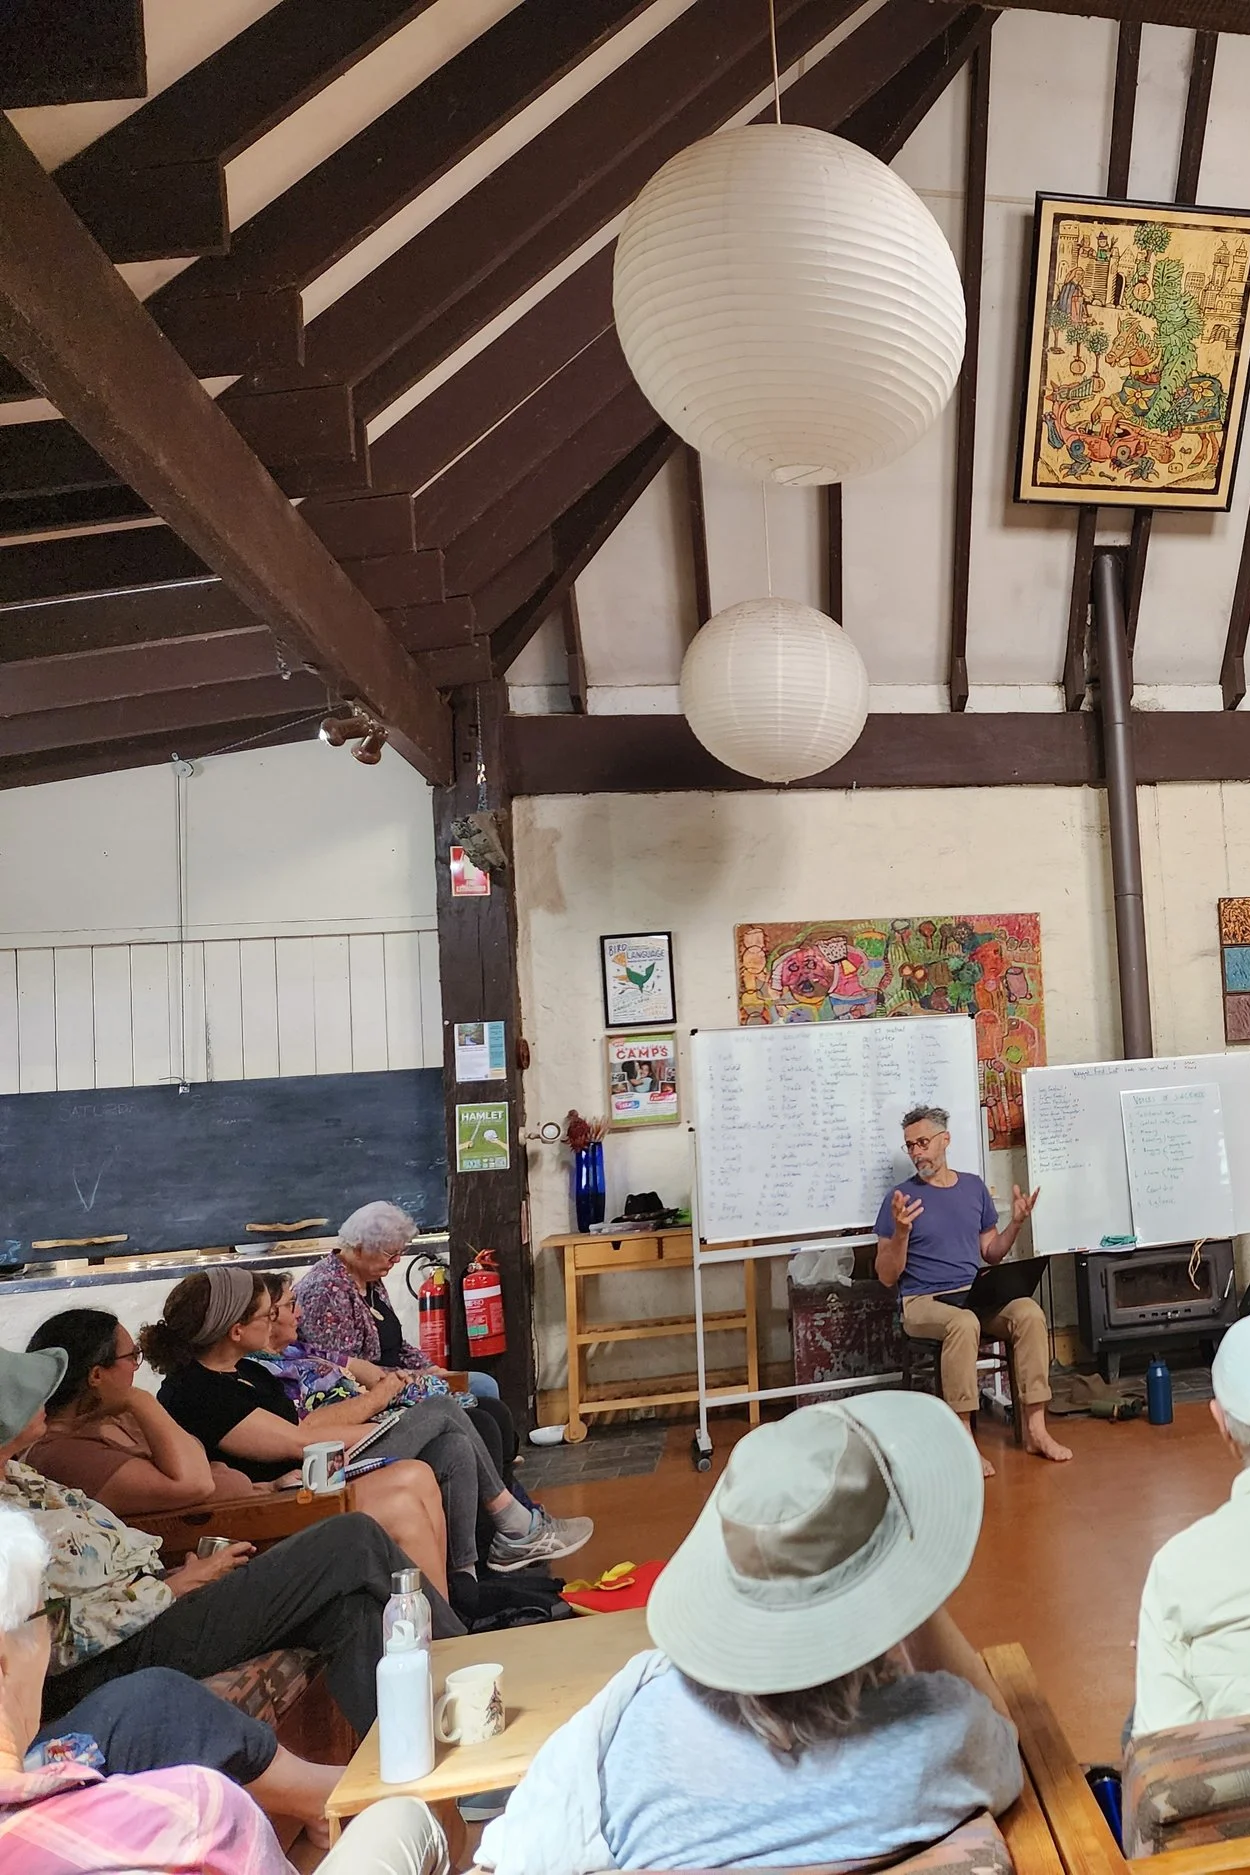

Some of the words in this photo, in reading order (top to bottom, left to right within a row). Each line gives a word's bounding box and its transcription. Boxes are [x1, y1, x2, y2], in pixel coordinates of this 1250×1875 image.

[608, 943, 628, 957] BIRD
[626, 949, 665, 960] LANGUAGE
[616, 1047, 669, 1060] CAMPS
[461, 1110, 505, 1122] HAMLET
